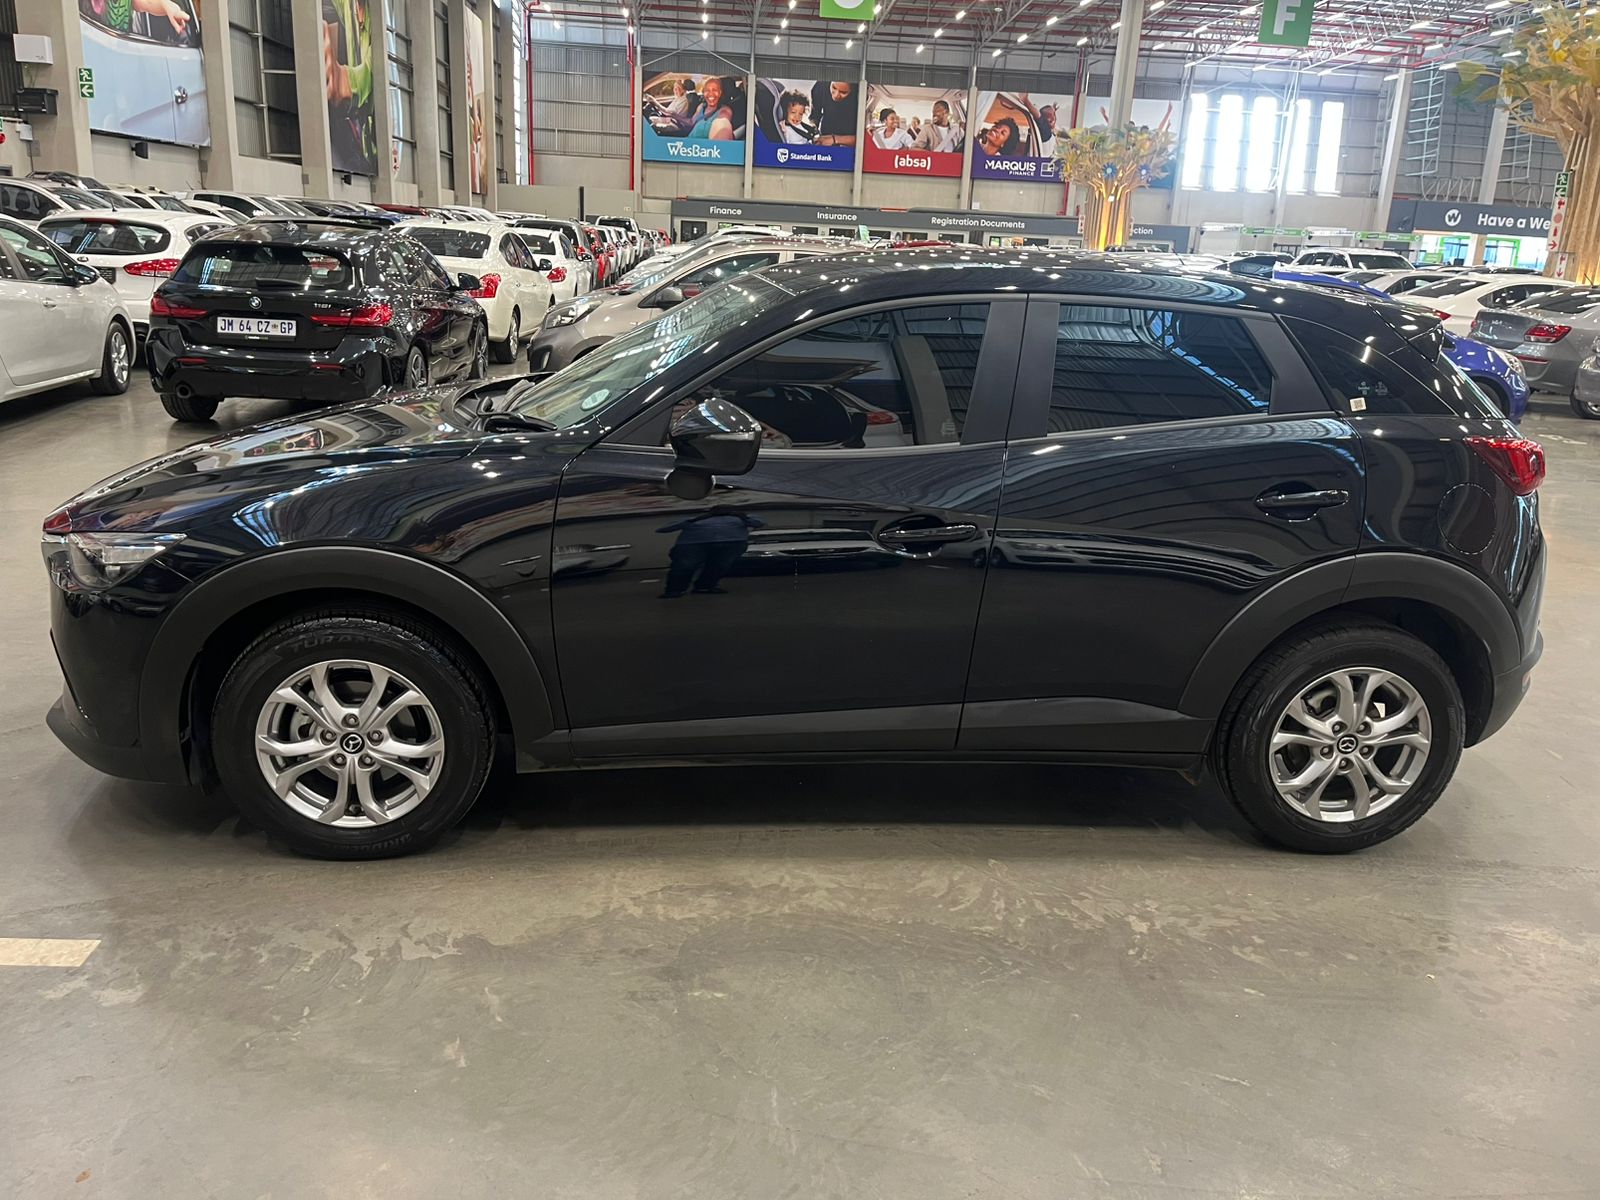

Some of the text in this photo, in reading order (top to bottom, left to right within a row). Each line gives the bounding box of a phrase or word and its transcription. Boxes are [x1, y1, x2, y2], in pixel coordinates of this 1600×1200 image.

[1273, 0, 1301, 35] F
[667, 141, 721, 159] WesBank
[790, 152, 832, 162] Standard Bank
[985, 159, 1036, 172] MARQUIS
[709, 206, 742, 215] Finance
[817, 211, 858, 221] Insurance
[931, 216, 1025, 229] Registration Documents
[1477, 213, 1514, 228] Have
[1516, 218, 1526, 228] a
[220, 319, 293, 334] JM 64 CZ GP
